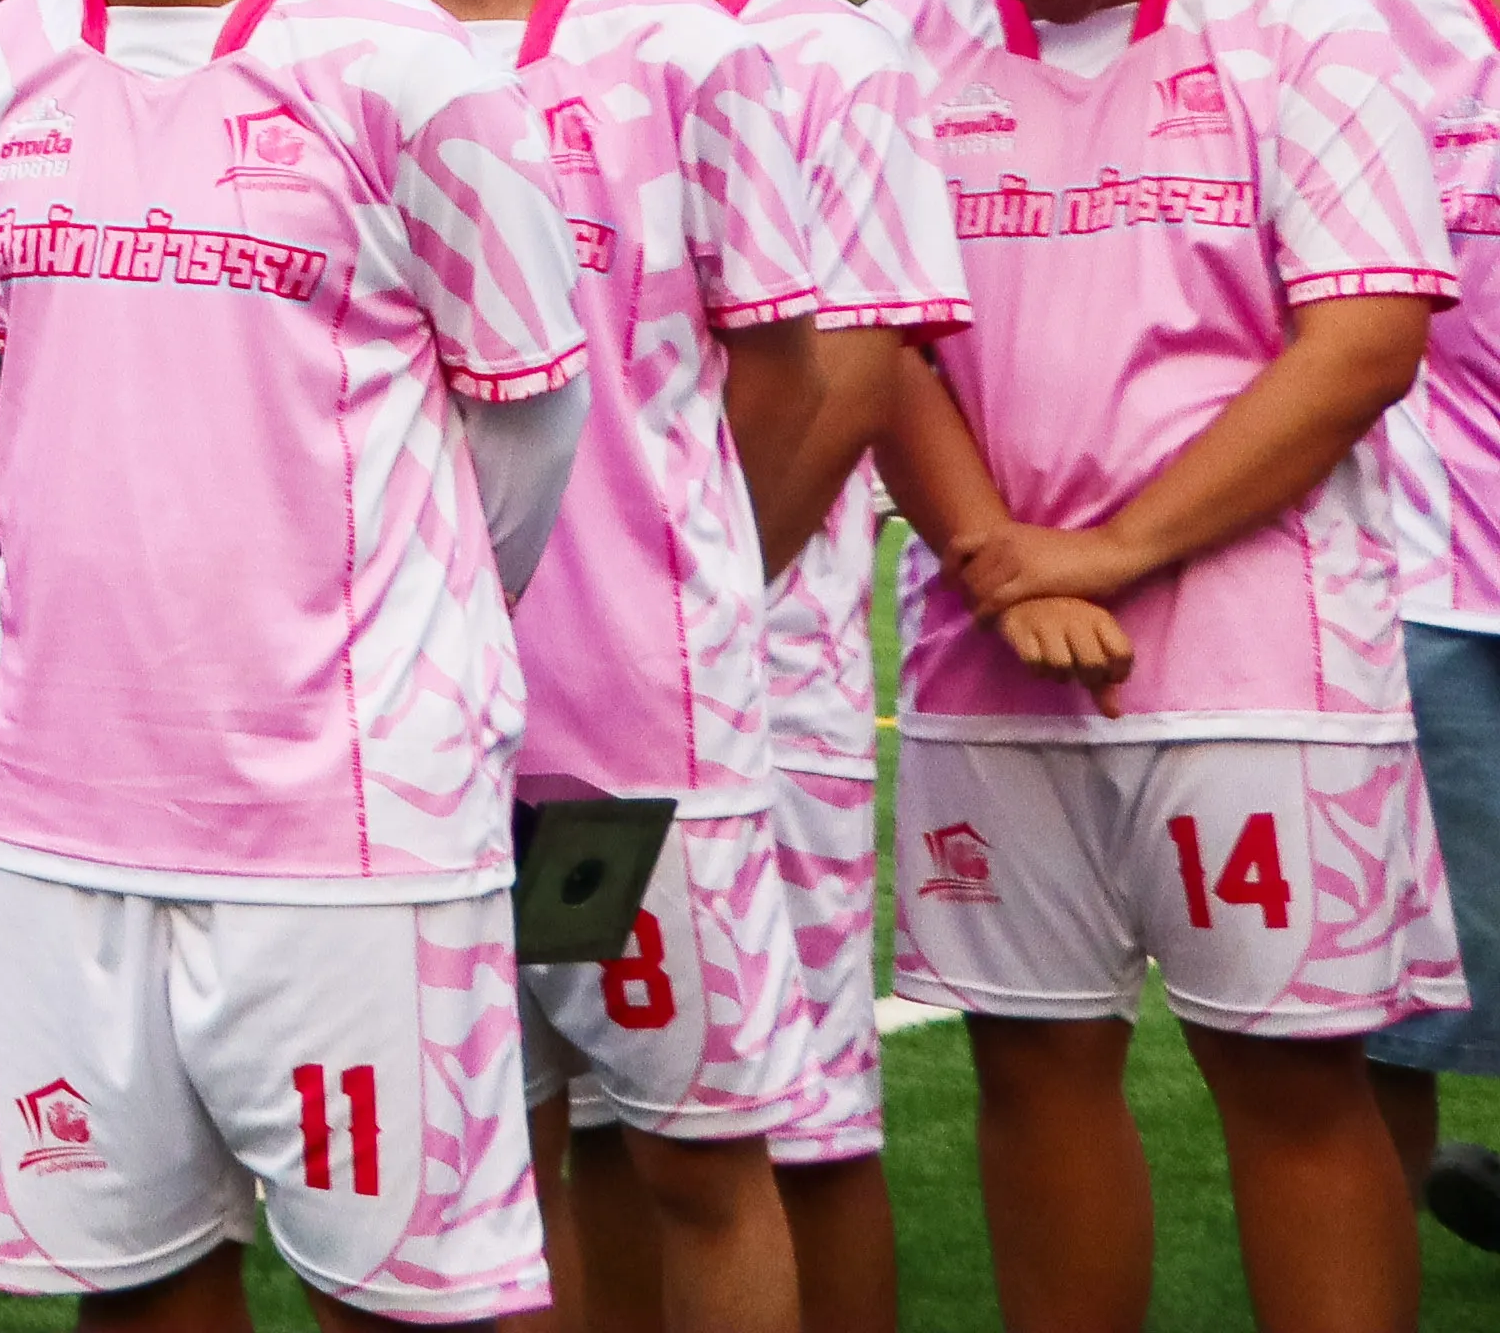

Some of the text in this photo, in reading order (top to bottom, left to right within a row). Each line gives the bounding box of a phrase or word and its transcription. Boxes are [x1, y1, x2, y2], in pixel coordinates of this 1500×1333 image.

[1166, 812, 1292, 930] 14
[599, 910, 677, 1030] 8
[291, 1062, 381, 1197] 11
